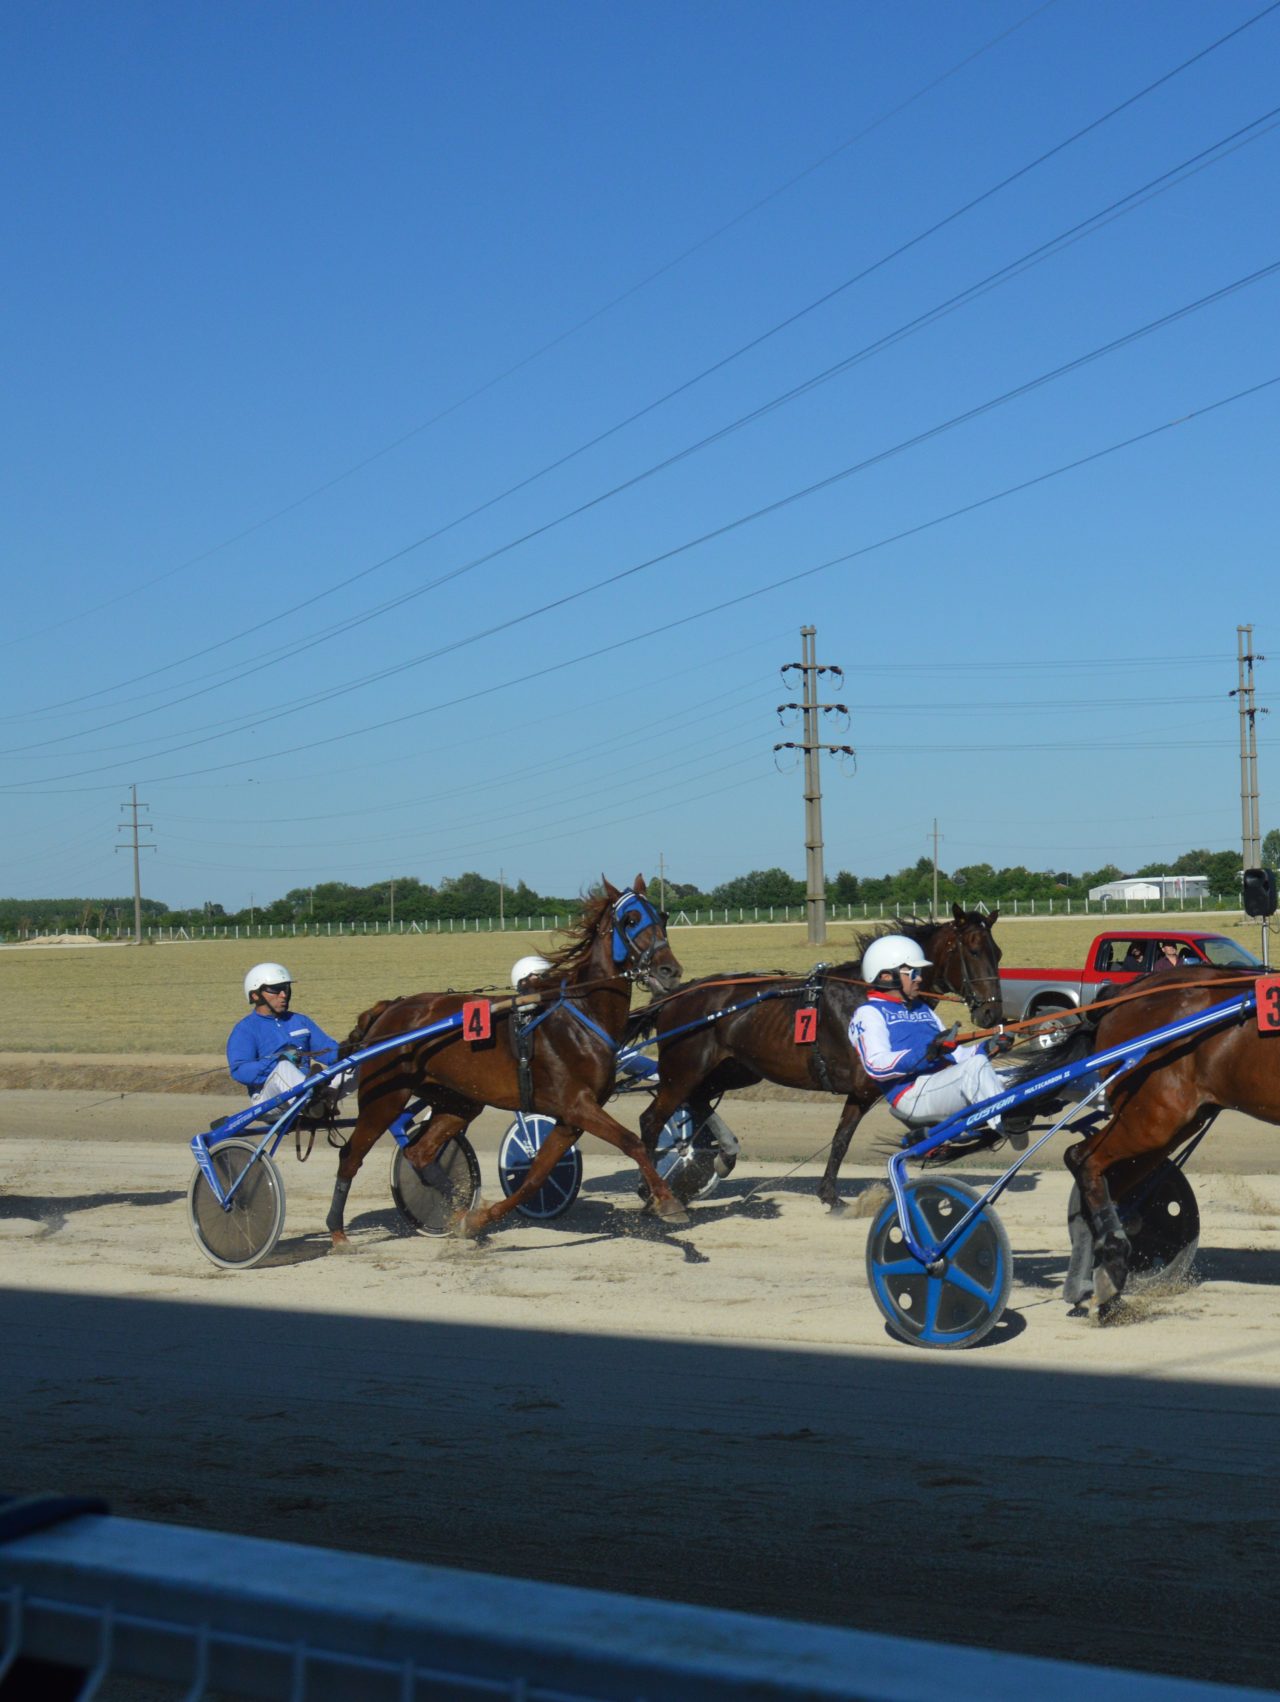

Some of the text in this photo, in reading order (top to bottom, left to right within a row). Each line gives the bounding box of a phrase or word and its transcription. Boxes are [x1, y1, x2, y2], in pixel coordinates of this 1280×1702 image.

[468, 1007, 484, 1037] 4
[800, 1015, 812, 1041] 7
[965, 1094, 1017, 1126] CUSTOM
